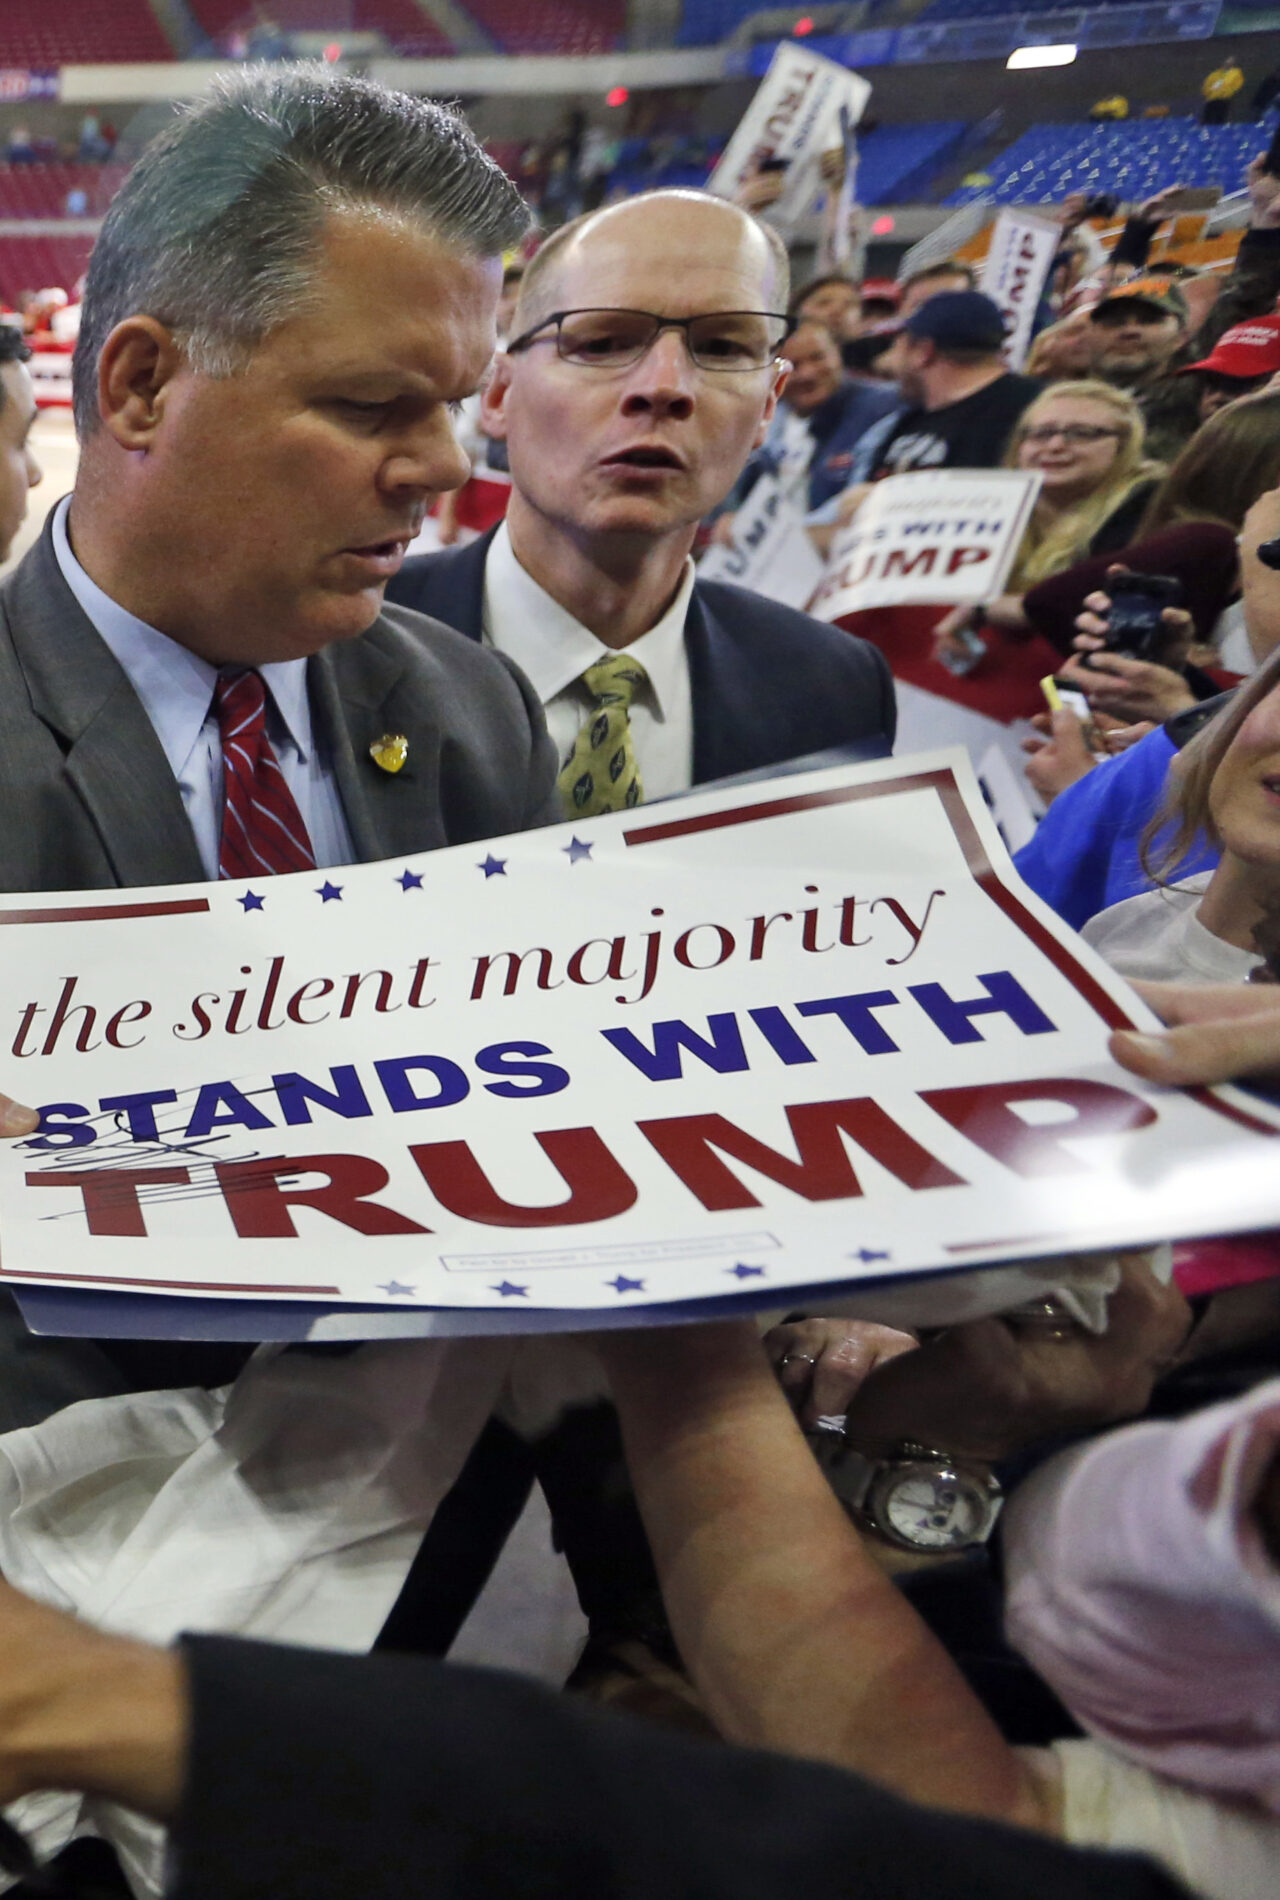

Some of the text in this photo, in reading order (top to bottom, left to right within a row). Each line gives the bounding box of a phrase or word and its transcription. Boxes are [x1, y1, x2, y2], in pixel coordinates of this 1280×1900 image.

[902, 517, 1005, 537] WITH
[10, 885, 946, 1059] the silent majority
[23, 1040, 570, 1149] STANDS
[600, 970, 1059, 1082] WITH
[24, 1077, 1159, 1239] TRUMP
